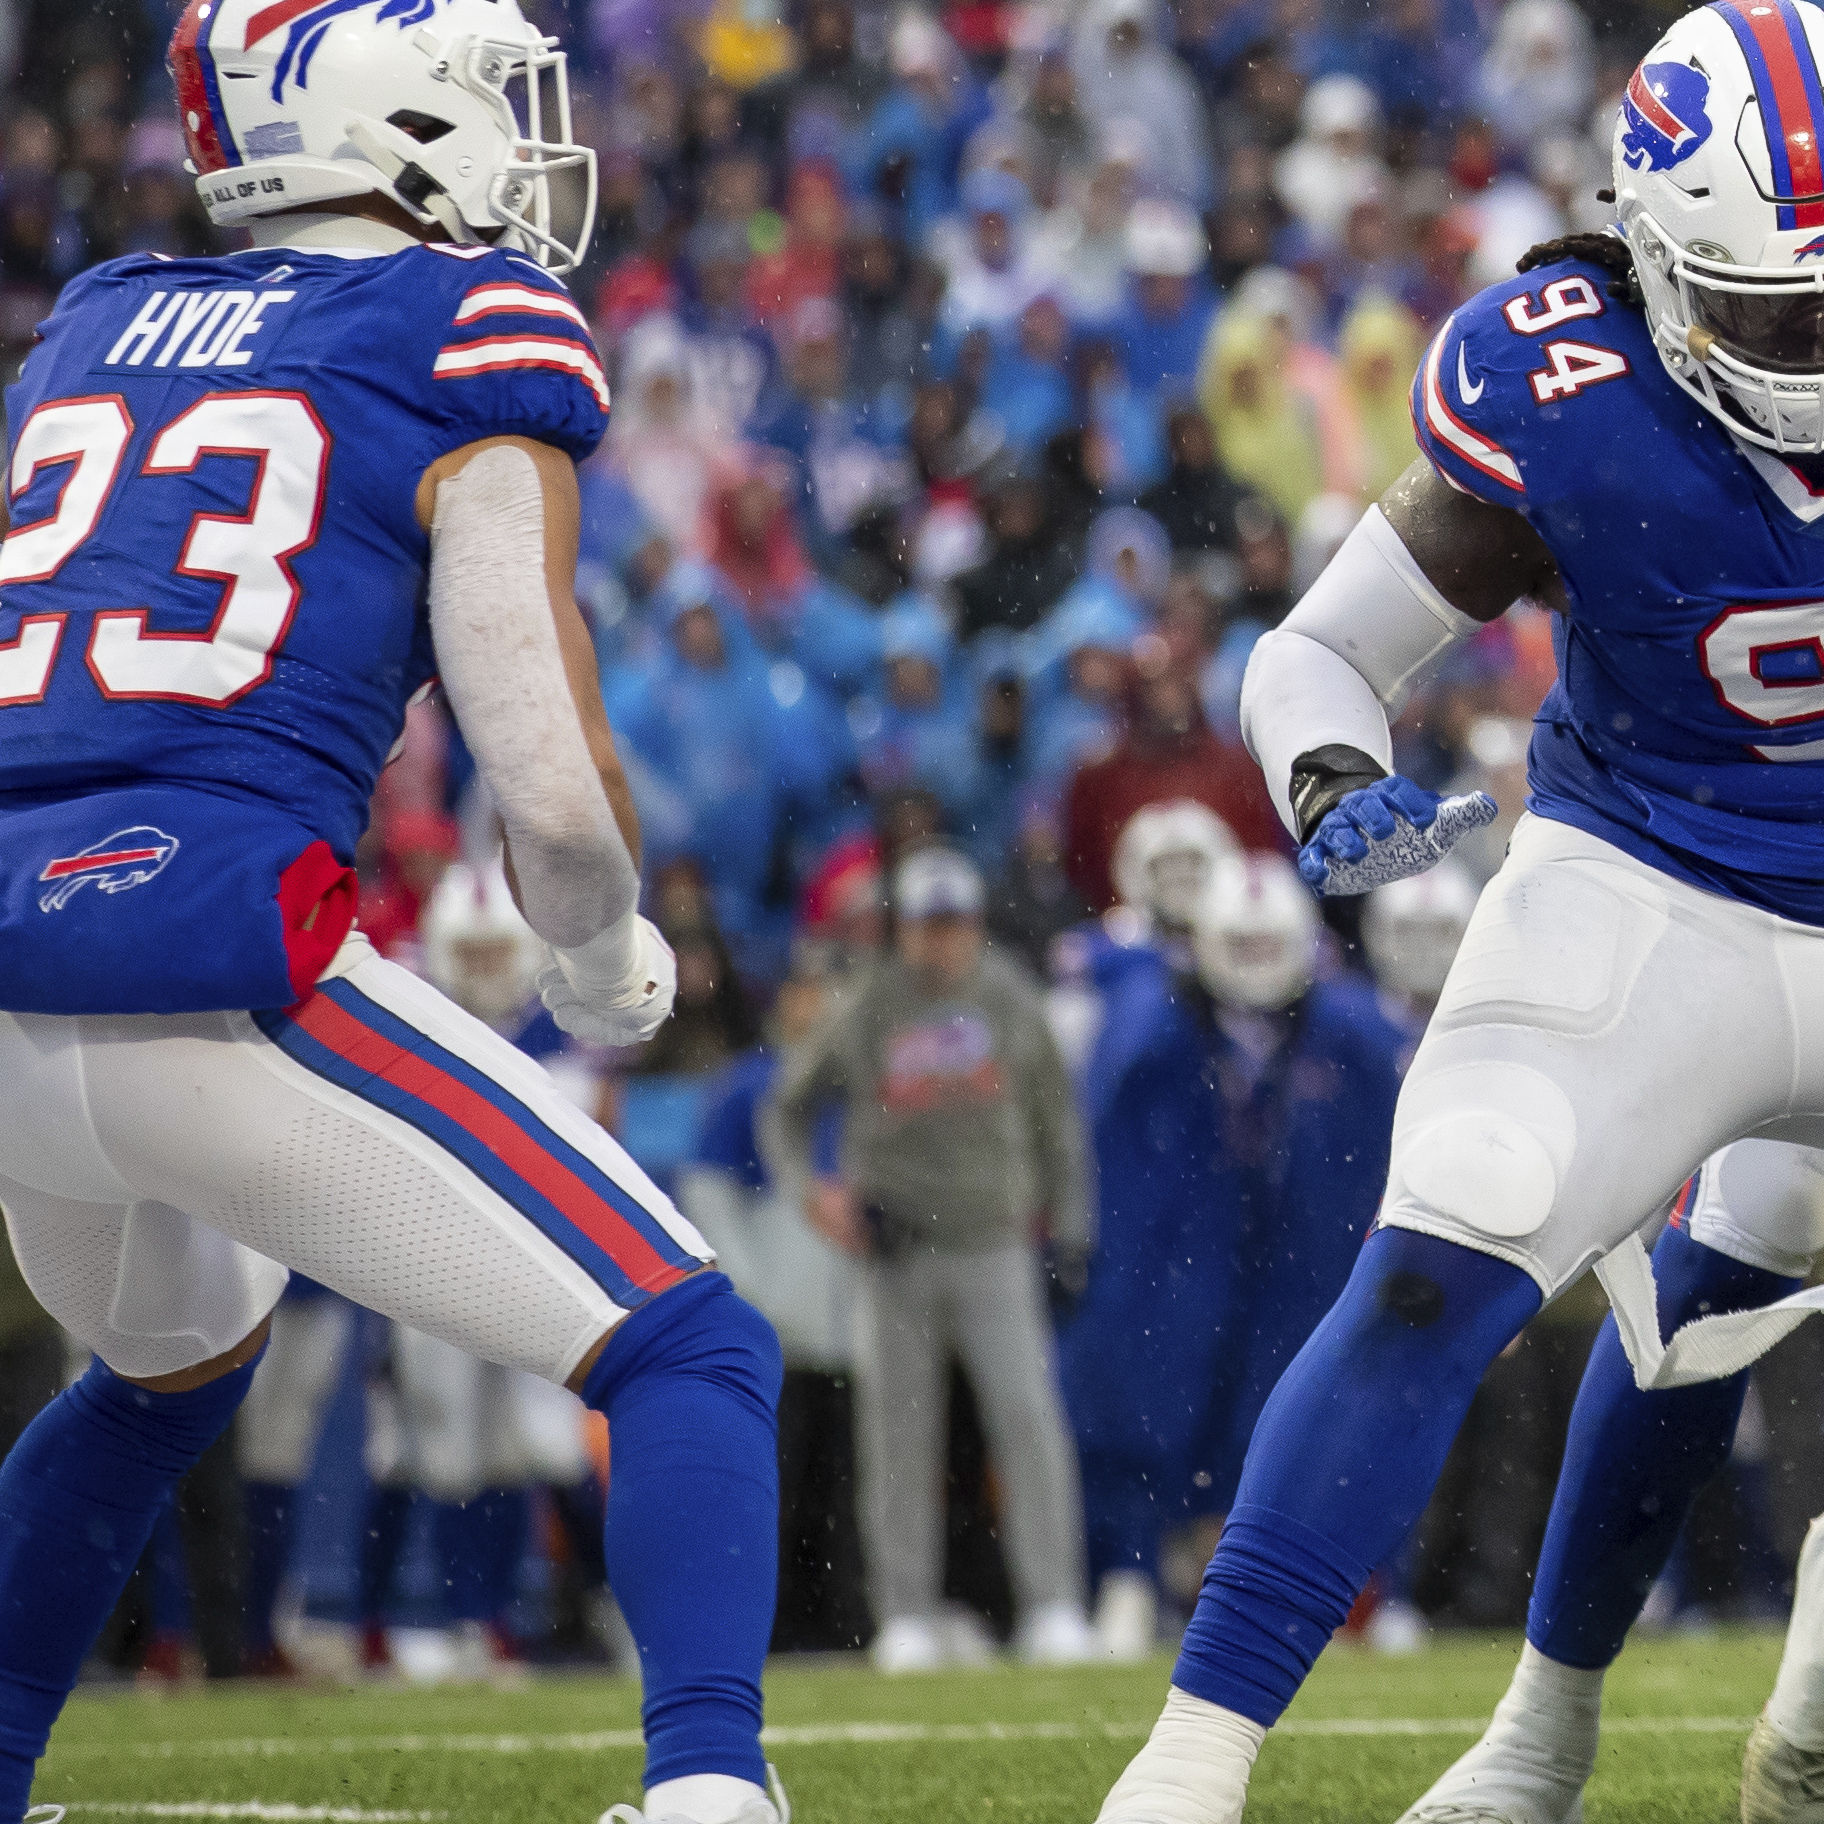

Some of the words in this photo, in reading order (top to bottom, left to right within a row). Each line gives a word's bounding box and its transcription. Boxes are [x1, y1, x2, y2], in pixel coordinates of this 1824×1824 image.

[237, 181, 256, 198] OF
[260, 178, 284, 194] US
[105, 290, 297, 368] HYDE
[1502, 274, 1634, 408] 94
[0, 388, 335, 710] 23
